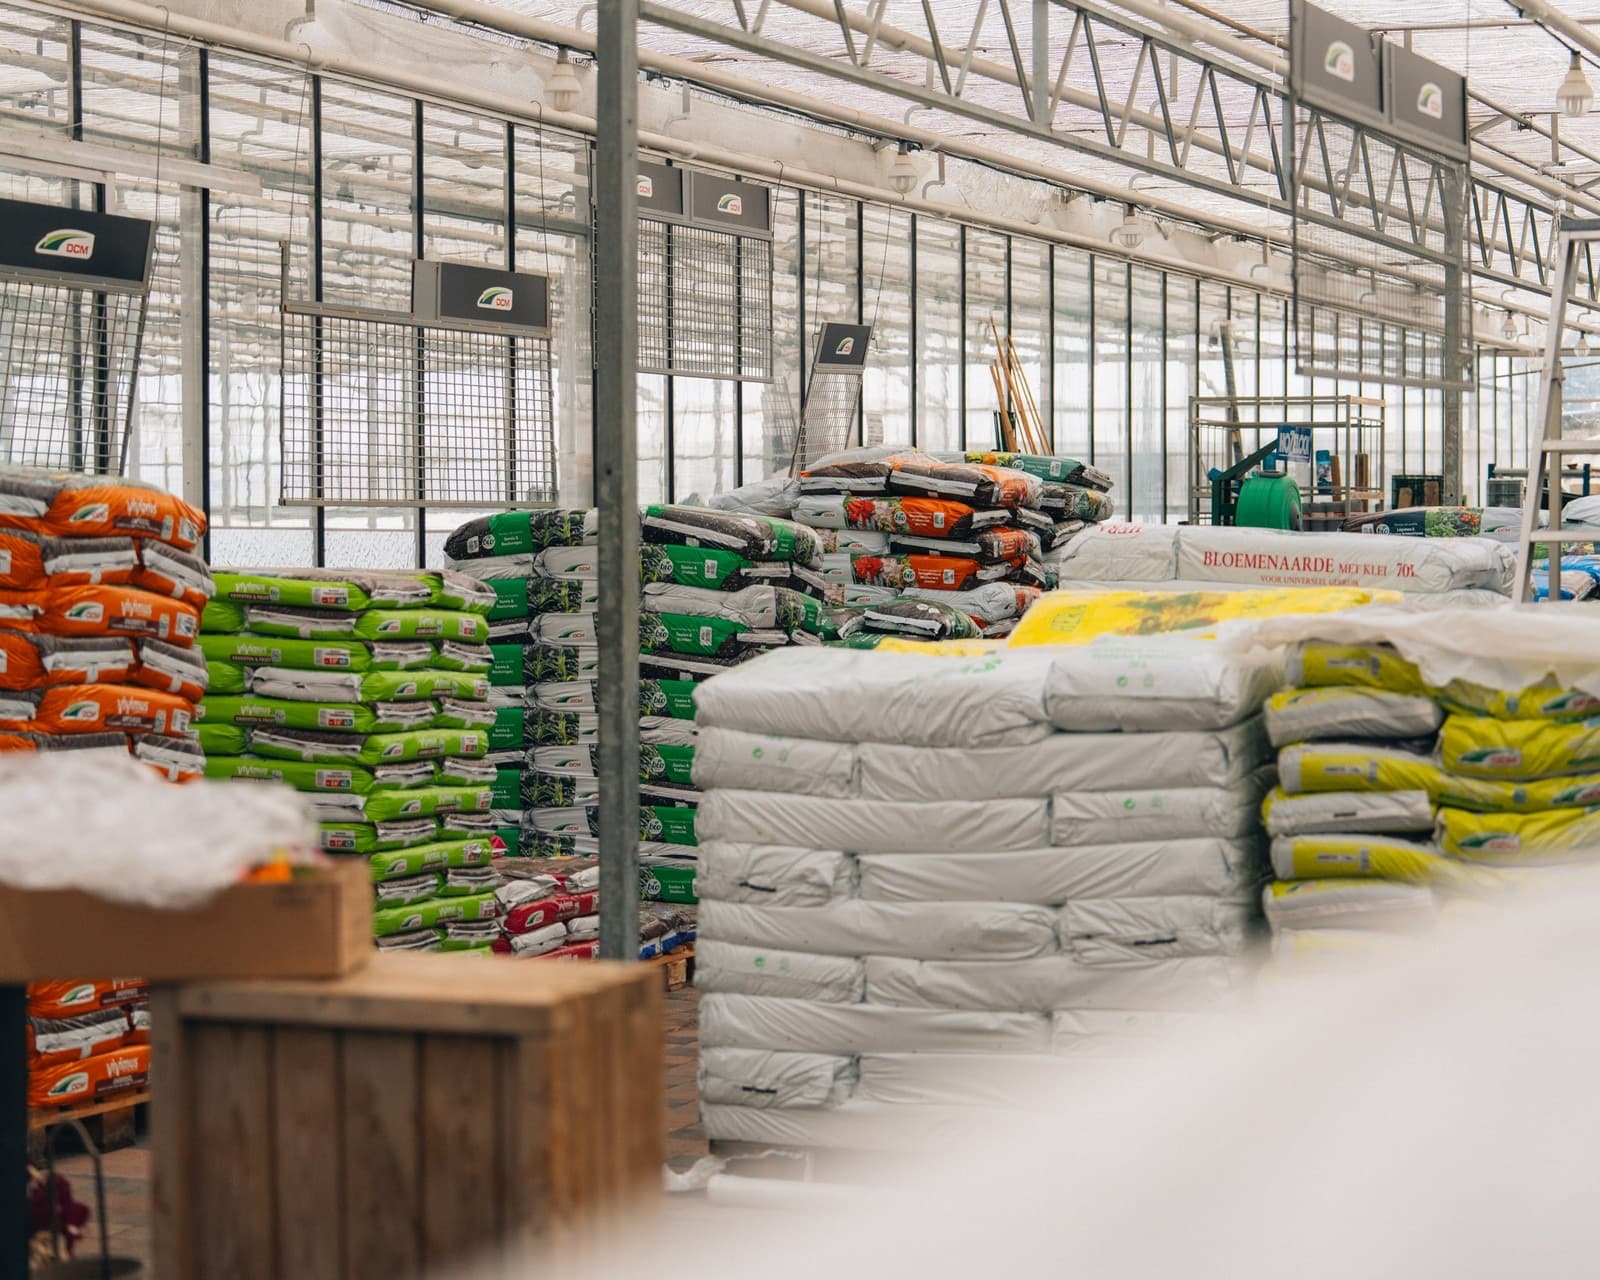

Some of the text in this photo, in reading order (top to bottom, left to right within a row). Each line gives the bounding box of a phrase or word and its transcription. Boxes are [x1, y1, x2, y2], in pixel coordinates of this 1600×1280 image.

[66, 243, 89, 254] DCM
[496, 298, 510, 307] DCM
[1203, 550, 1334, 573] BLOEMENAARDE
[1338, 563, 1359, 574] MET
[1363, 564, 1387, 576] KLEI
[1260, 575, 1282, 584] VOOR
